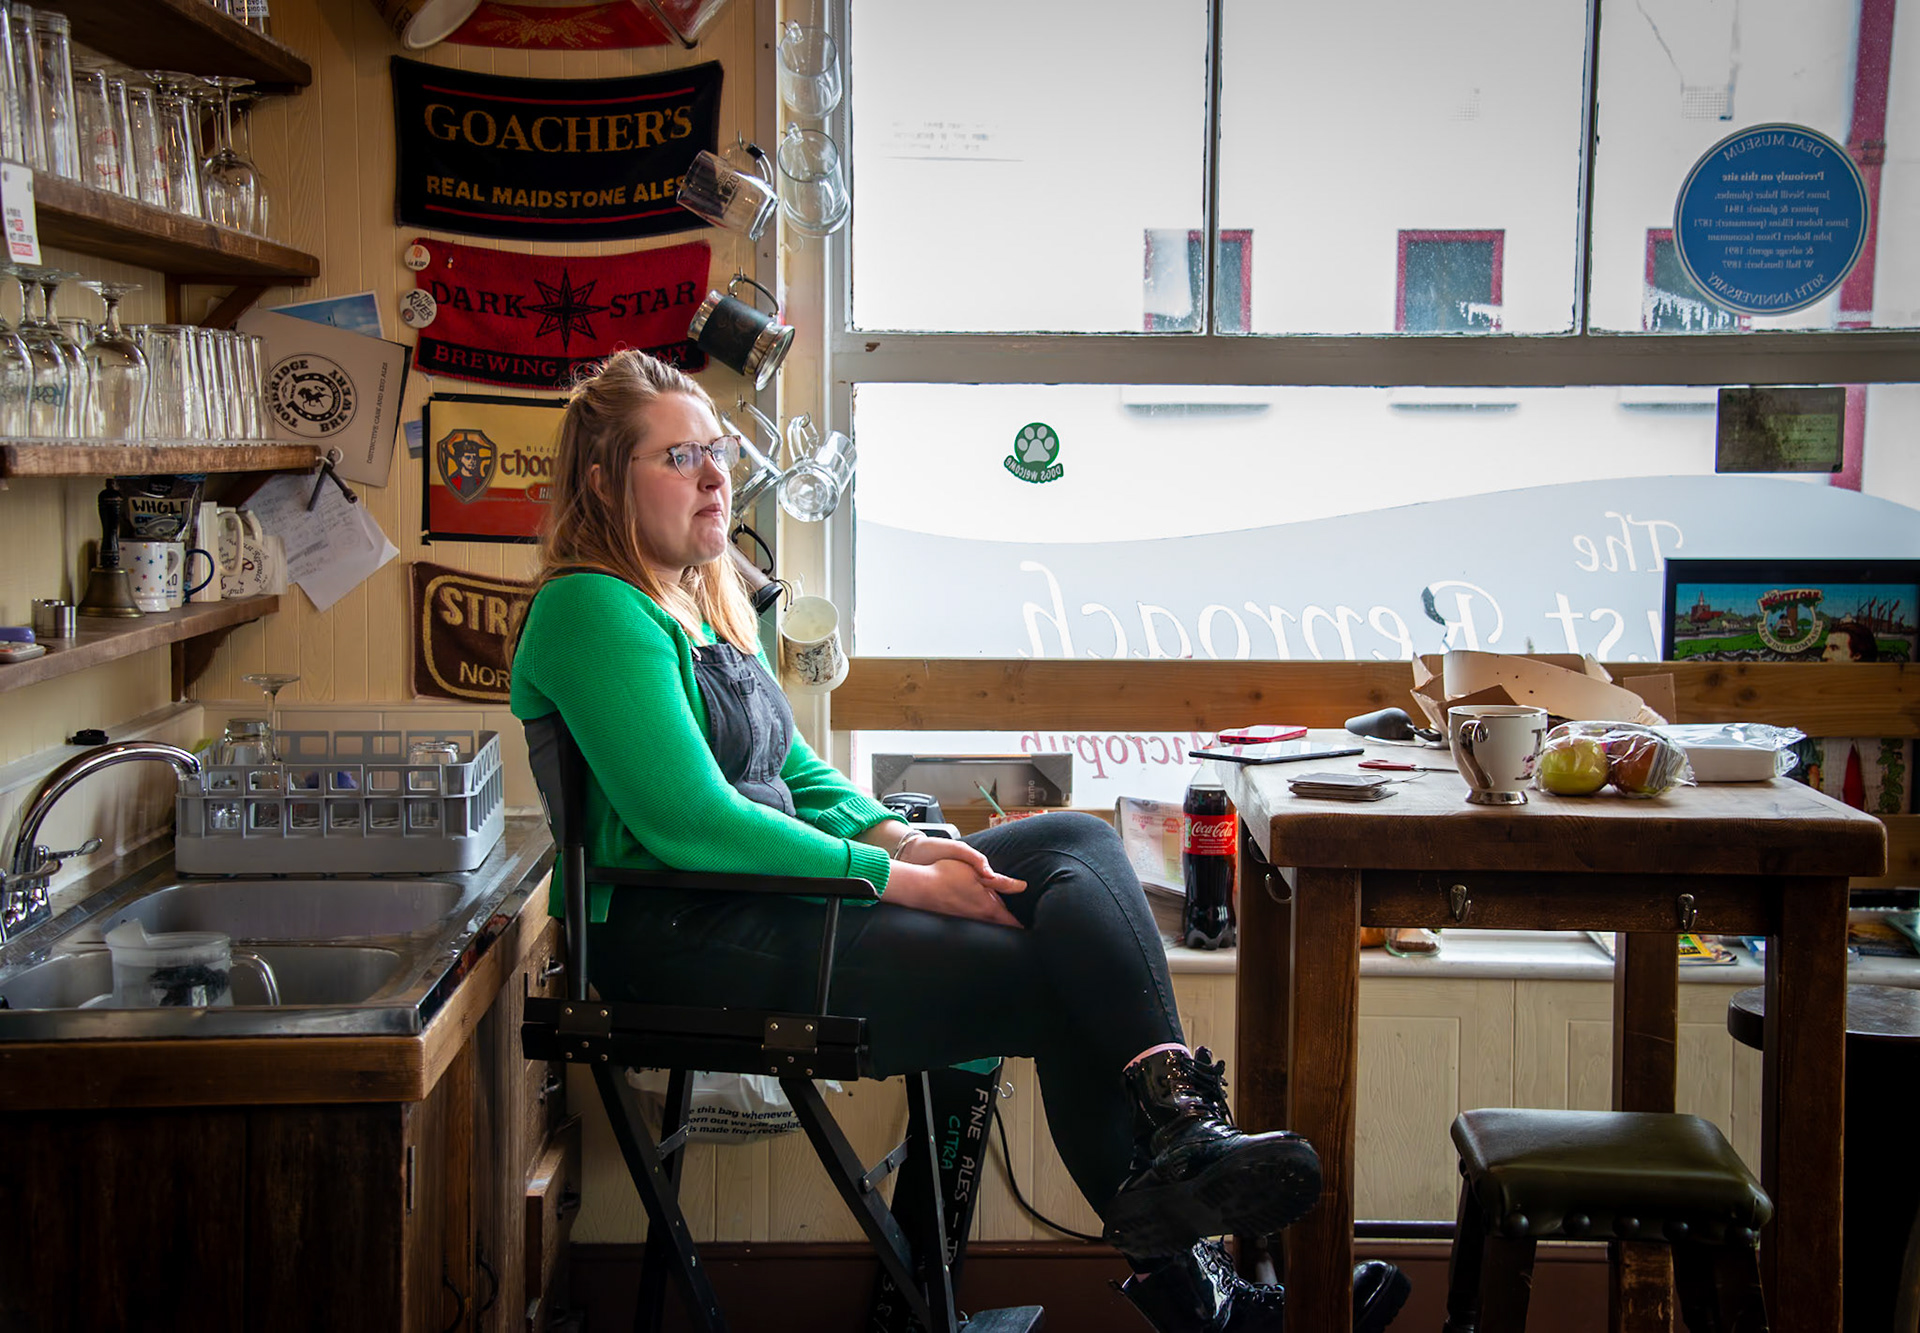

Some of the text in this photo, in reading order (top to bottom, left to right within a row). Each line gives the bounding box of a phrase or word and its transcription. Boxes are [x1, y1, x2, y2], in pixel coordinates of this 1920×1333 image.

[423, 103, 693, 153] GOACHER'S
[426, 175, 485, 202] REAL
[492, 186, 626, 209] MAIDSTONE
[633, 175, 690, 203] ALES
[406, 291, 434, 321] RIVER
[429, 280, 697, 320] DARK STAR
[434, 344, 557, 378] BREWING
[271, 359, 309, 428] TONBRIDGE
[319, 369, 352, 432] BREWERY
[460, 661, 511, 689] NOR
[1191, 821, 1234, 838] Coca-Cola
[697, 1105, 717, 1114] this
[718, 1106, 740, 1118] bag
[742, 1110, 793, 1120] whenever
[699, 1125, 729, 1134] made
[710, 1117, 729, 1125] out
[731, 1119, 748, 1127] we
[769, 1120, 801, 1130] replac
[967, 1088, 989, 1140] FYNE
[941, 1115, 961, 1170] CITRA
[954, 1155, 975, 1202] ALES
